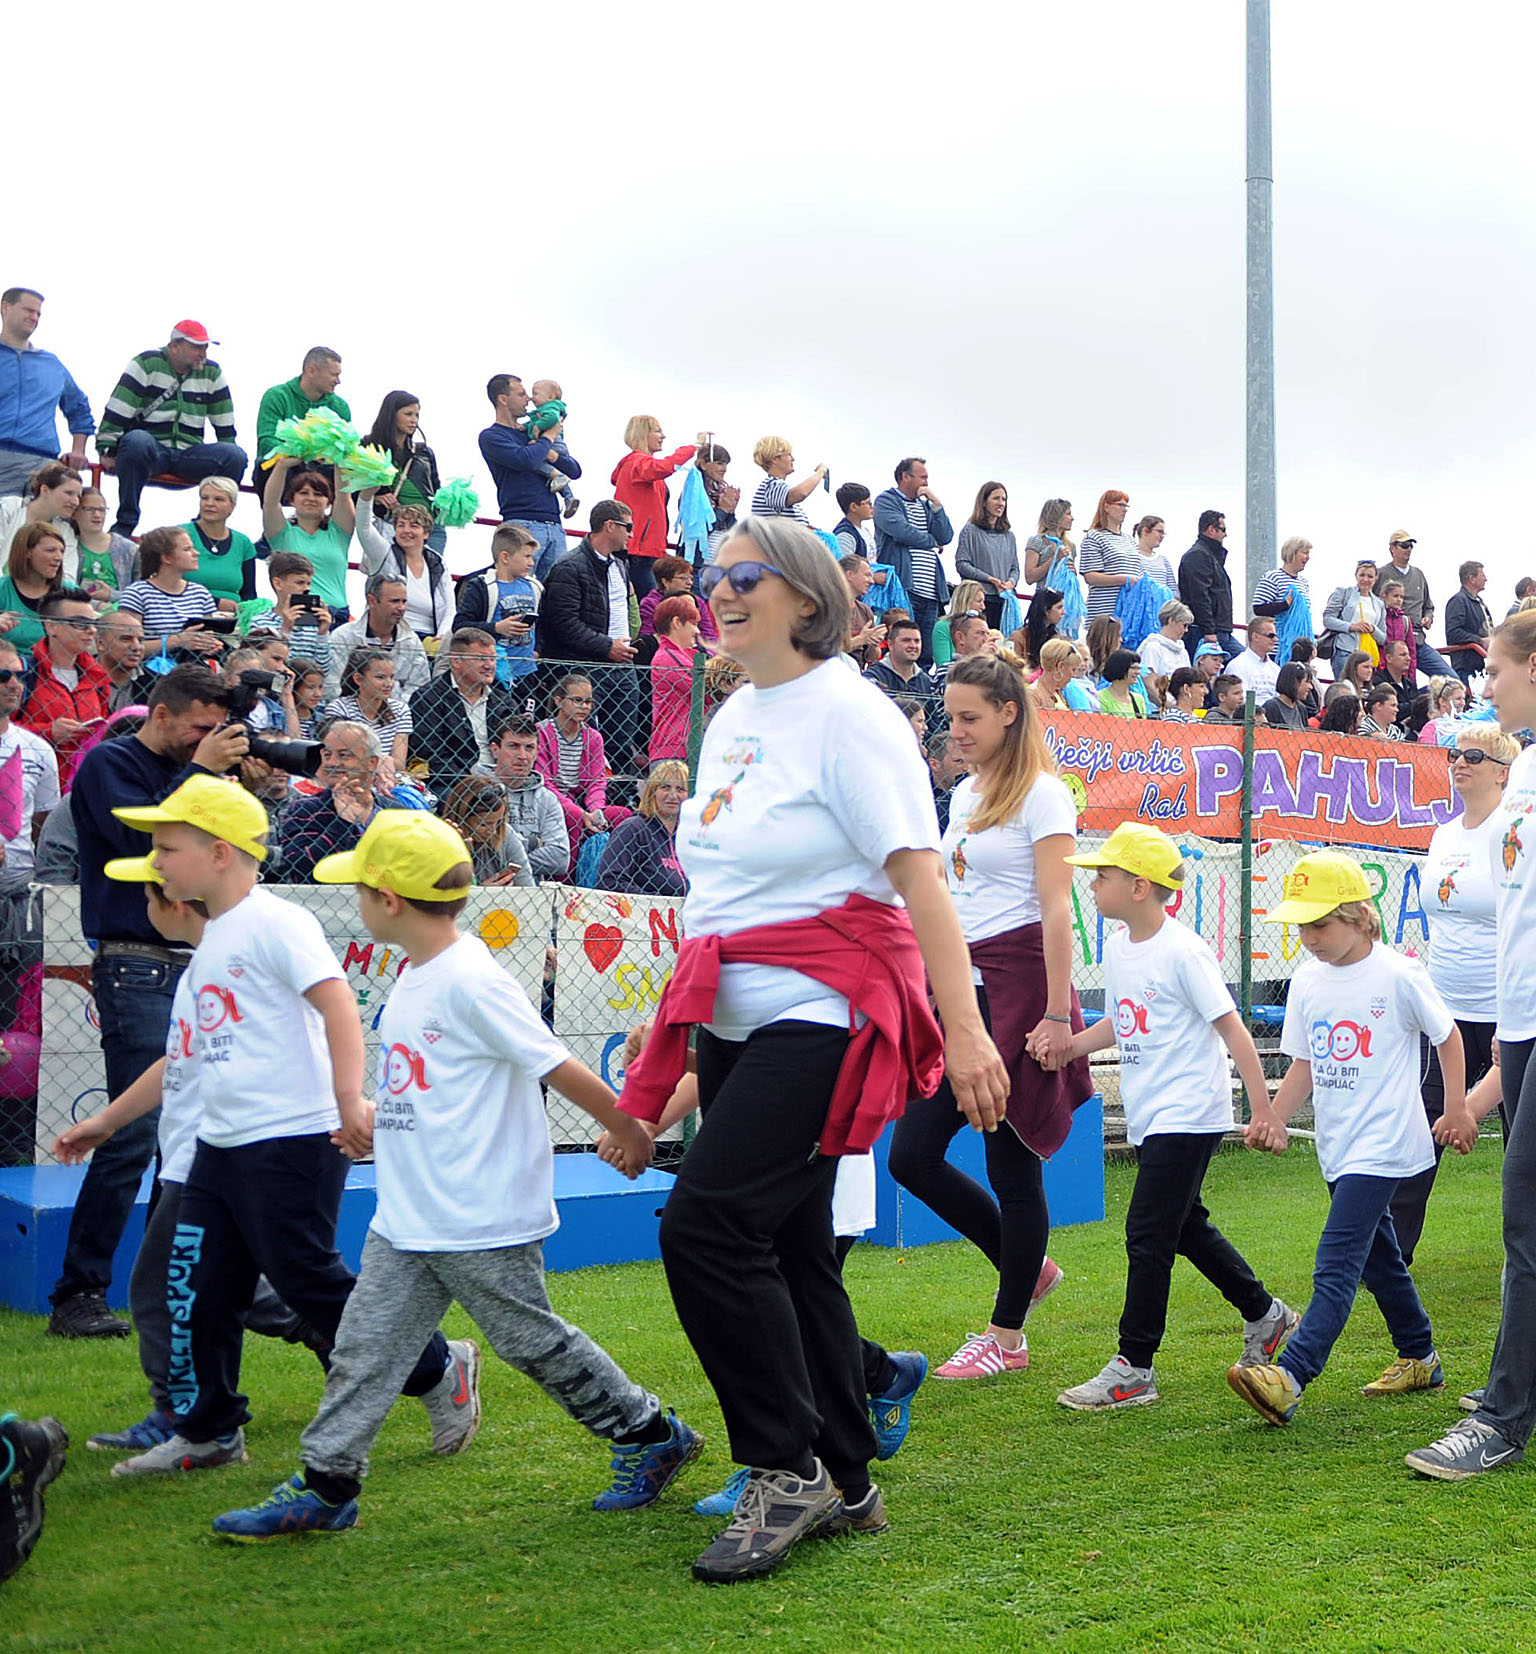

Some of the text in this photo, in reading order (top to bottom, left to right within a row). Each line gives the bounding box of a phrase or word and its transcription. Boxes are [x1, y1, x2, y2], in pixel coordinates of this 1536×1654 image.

[1118, 739, 1185, 774] vrtić
[1138, 782, 1187, 819] Rab
[1341, 1066, 1359, 1077] BITI
